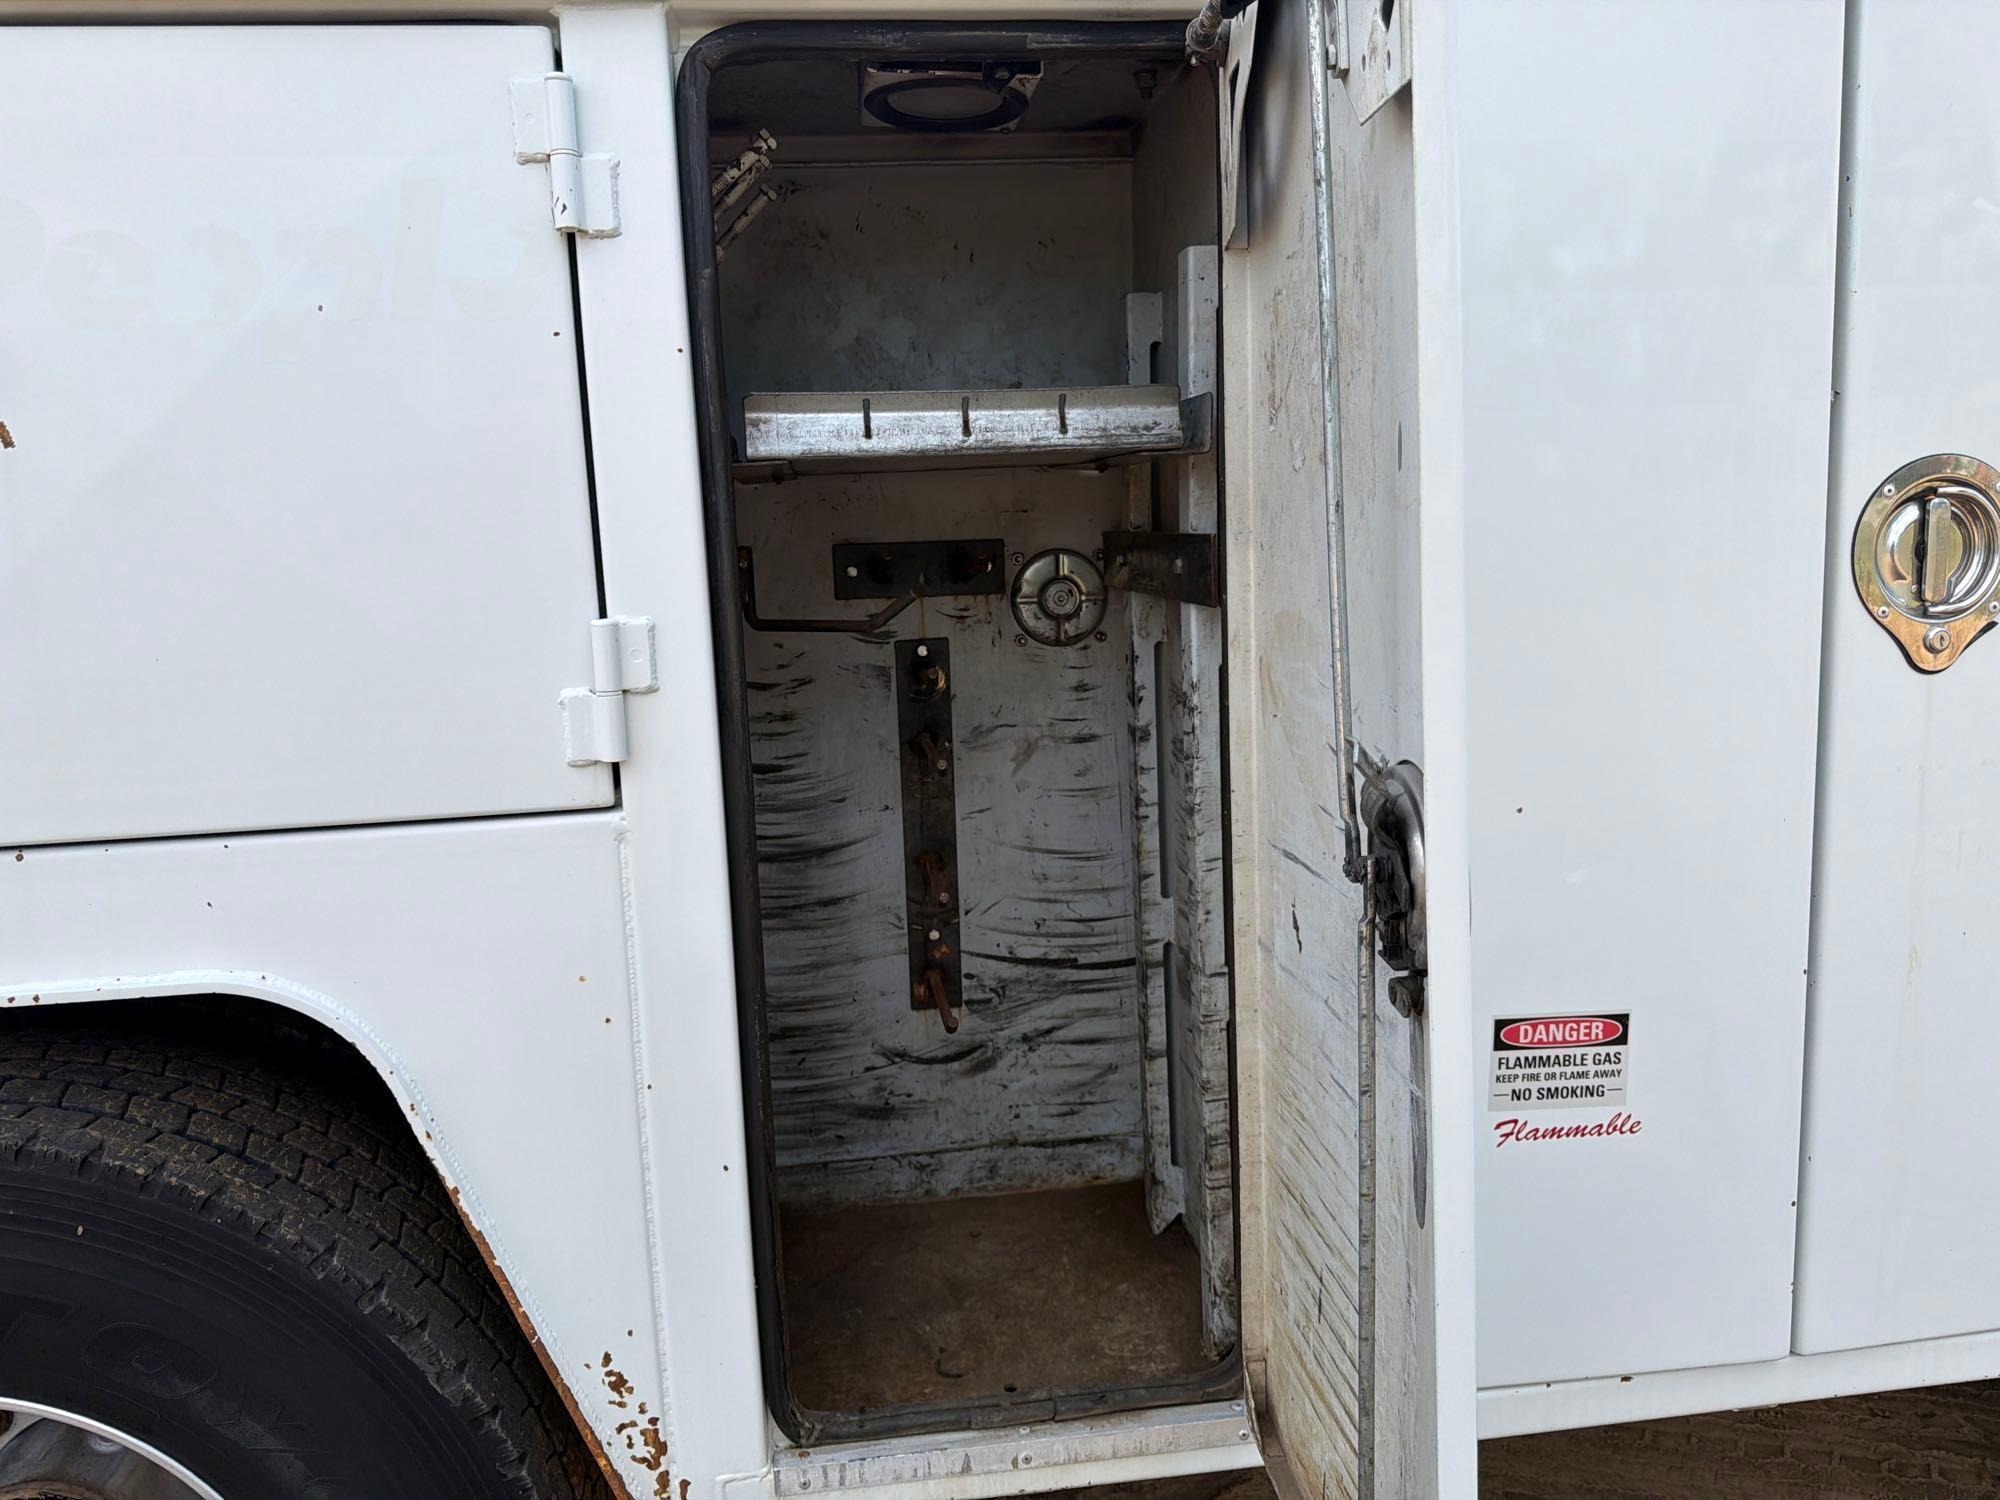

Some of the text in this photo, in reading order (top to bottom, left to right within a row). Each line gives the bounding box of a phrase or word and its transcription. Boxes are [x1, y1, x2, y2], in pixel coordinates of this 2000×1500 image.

[1519, 1021, 1604, 1044] DANGER
[1497, 1051, 1622, 1070] FLAMMABLE GAS
[1495, 1069, 1622, 1084] KEEP FIRE OR FLAME AWAY
[1510, 1084, 1605, 1101] NO SMOKING
[1494, 1111, 1643, 1148] Flammable
